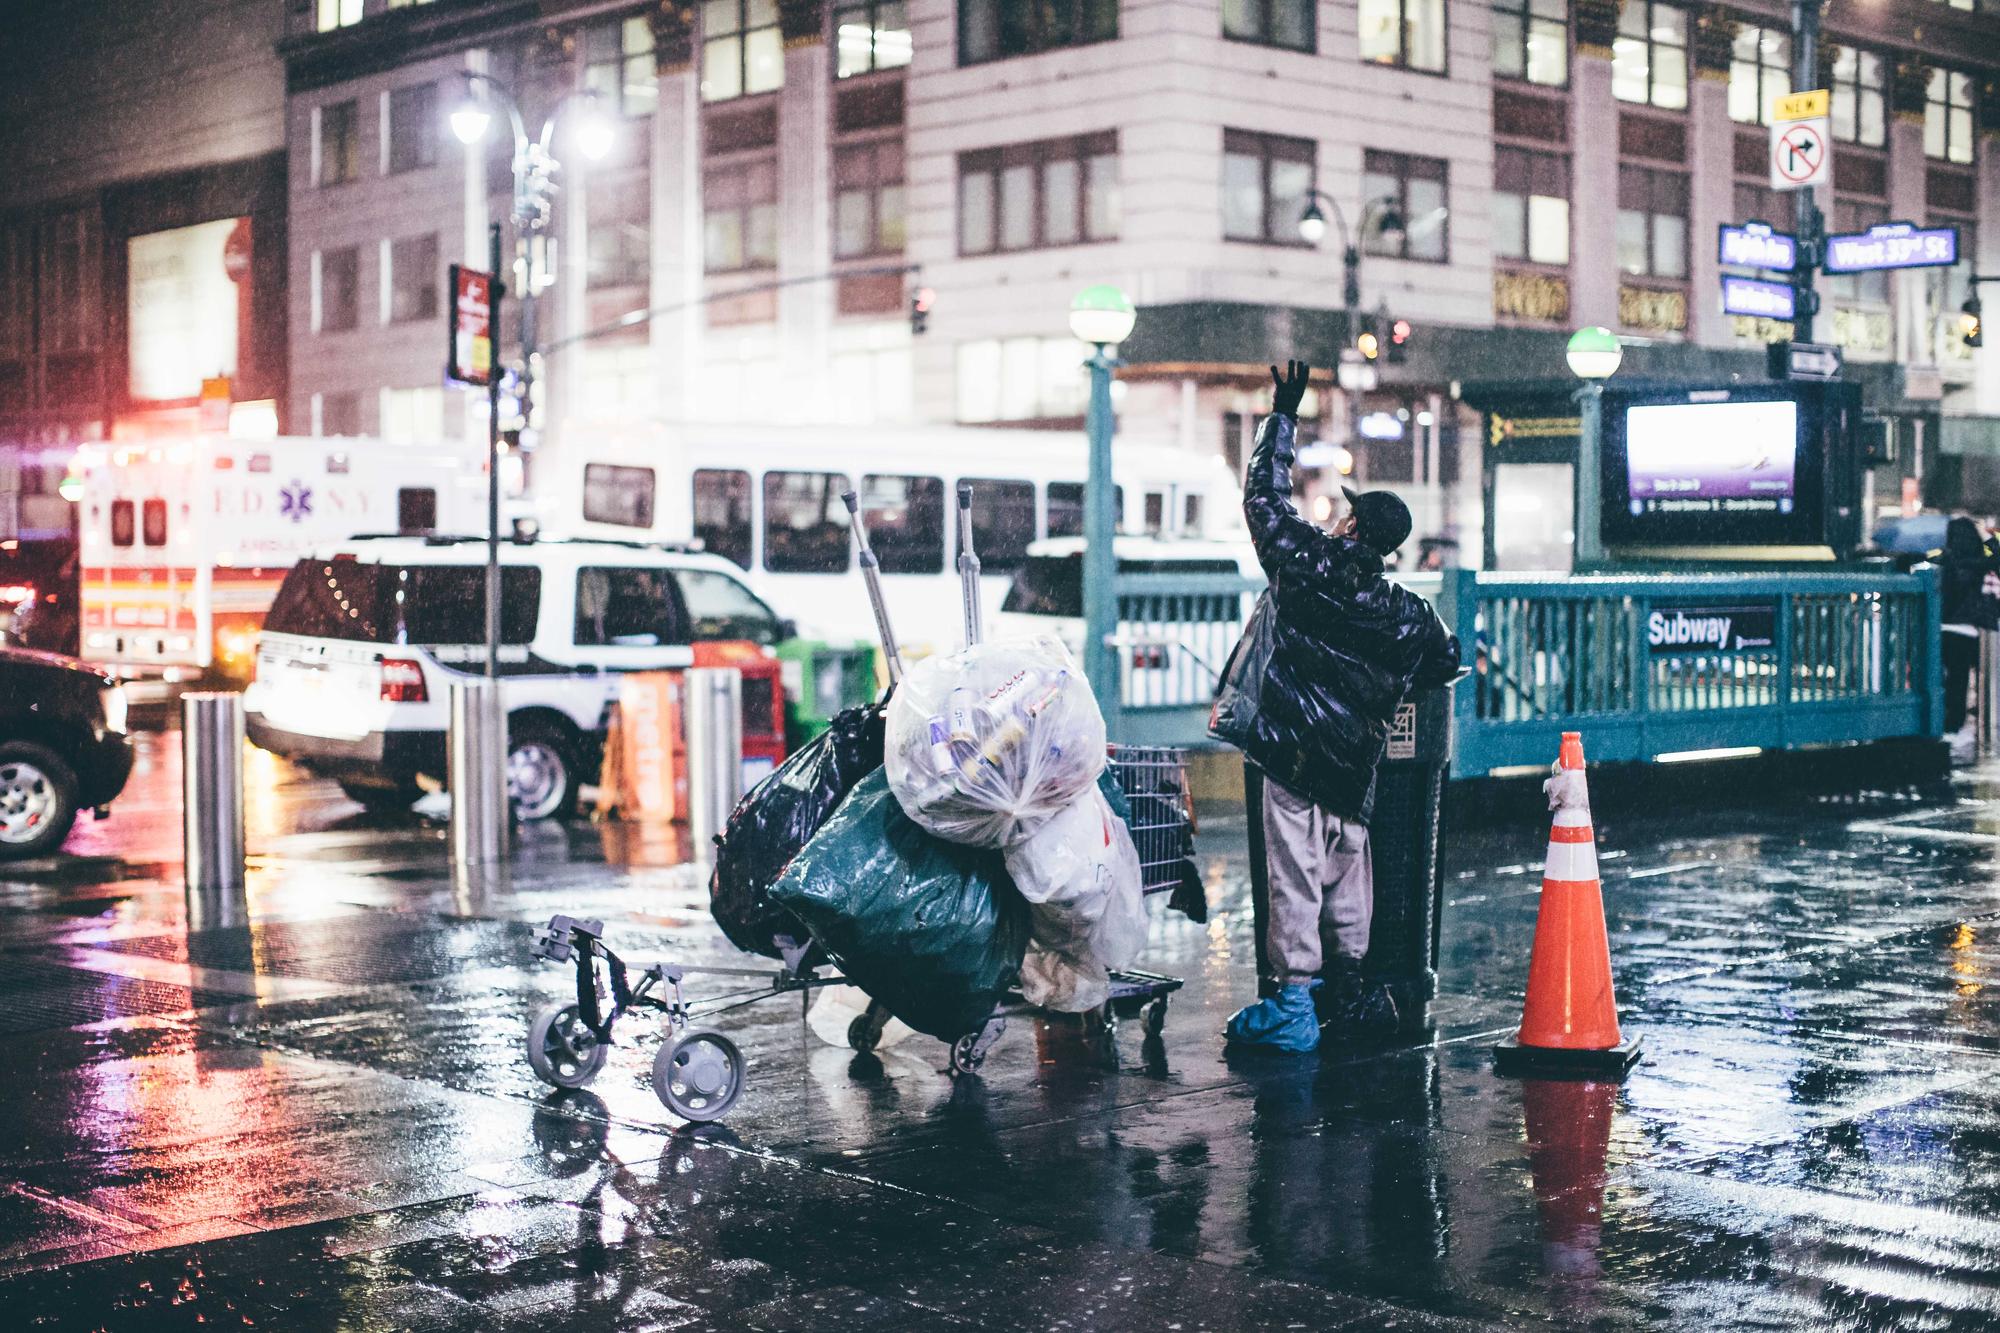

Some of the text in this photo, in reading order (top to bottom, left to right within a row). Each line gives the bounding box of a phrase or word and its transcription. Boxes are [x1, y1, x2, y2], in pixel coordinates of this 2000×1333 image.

[1834, 241, 1884, 266] West
[1924, 235, 1949, 259] St
[1649, 611, 1732, 650] Subway
